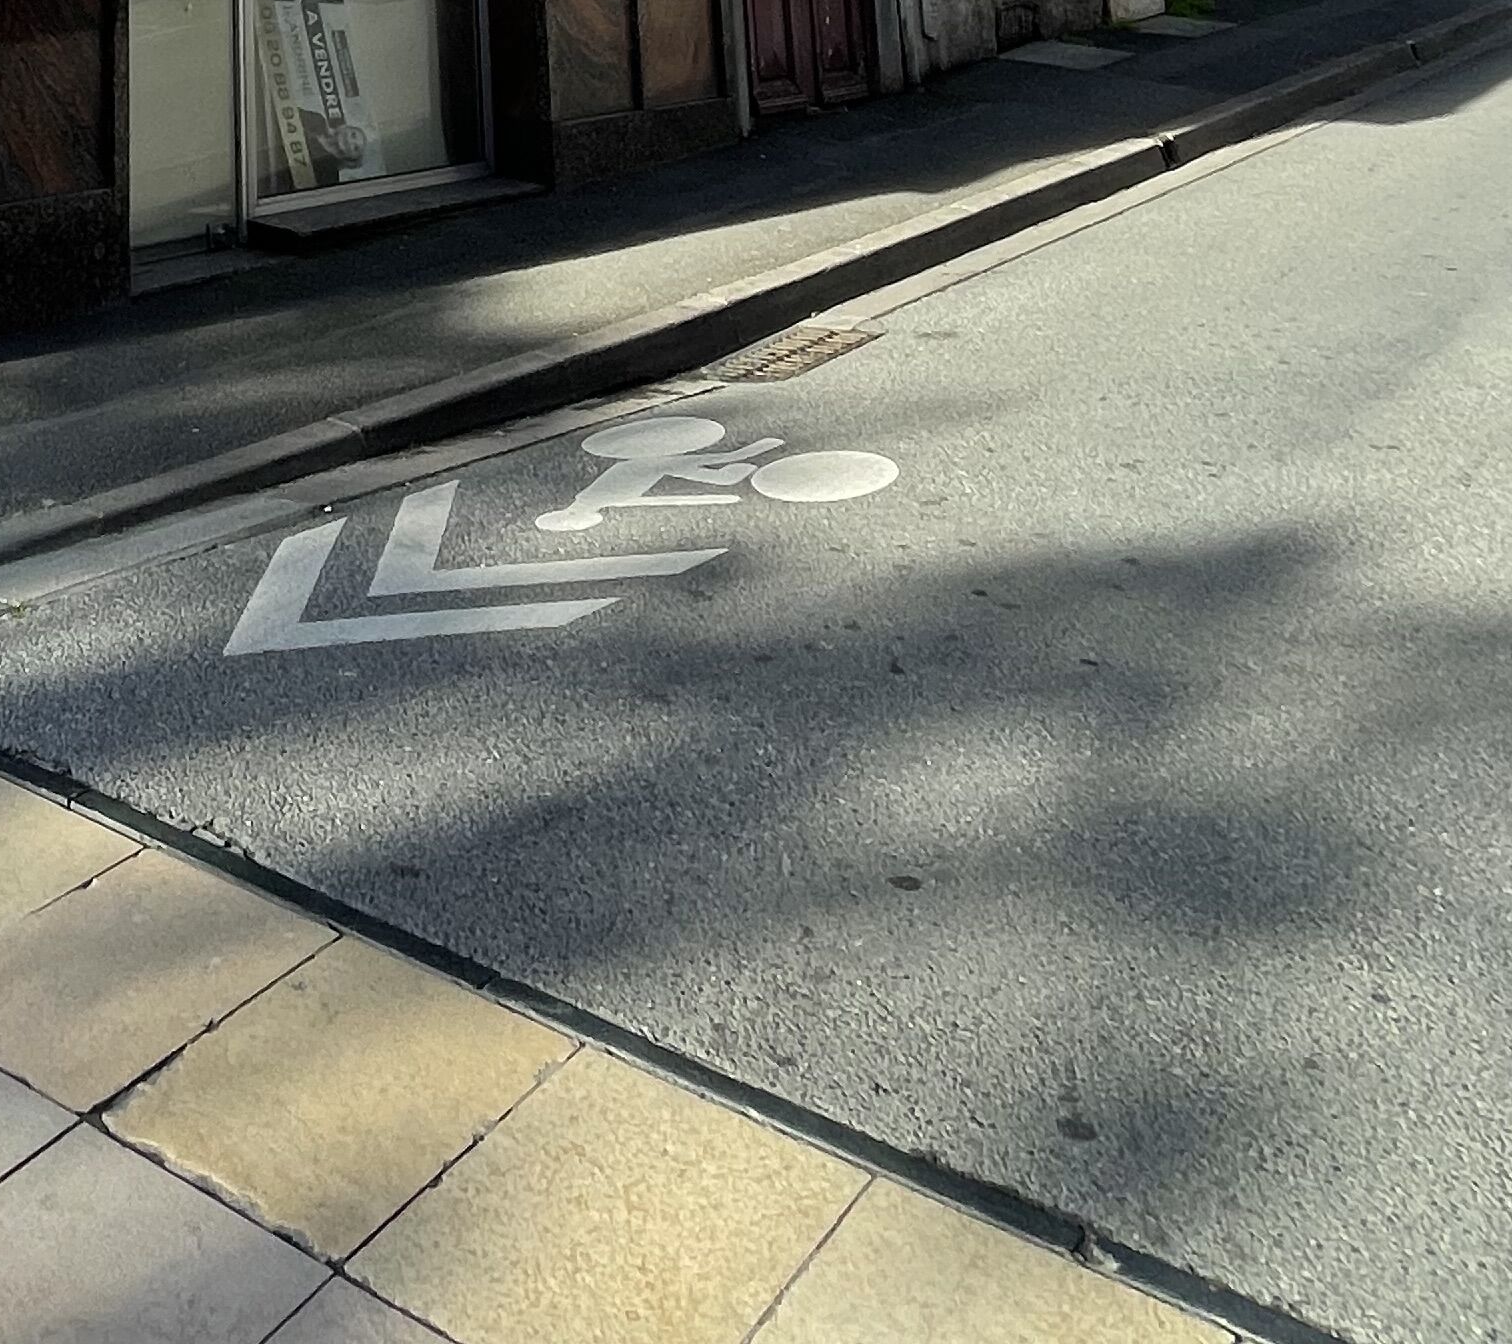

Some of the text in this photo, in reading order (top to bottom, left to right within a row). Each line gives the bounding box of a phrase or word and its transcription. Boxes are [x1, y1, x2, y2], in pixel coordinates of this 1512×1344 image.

[267, 40, 283, 68] 20
[289, 141, 308, 168] 87
[305, 11, 342, 120] A VENDRE
